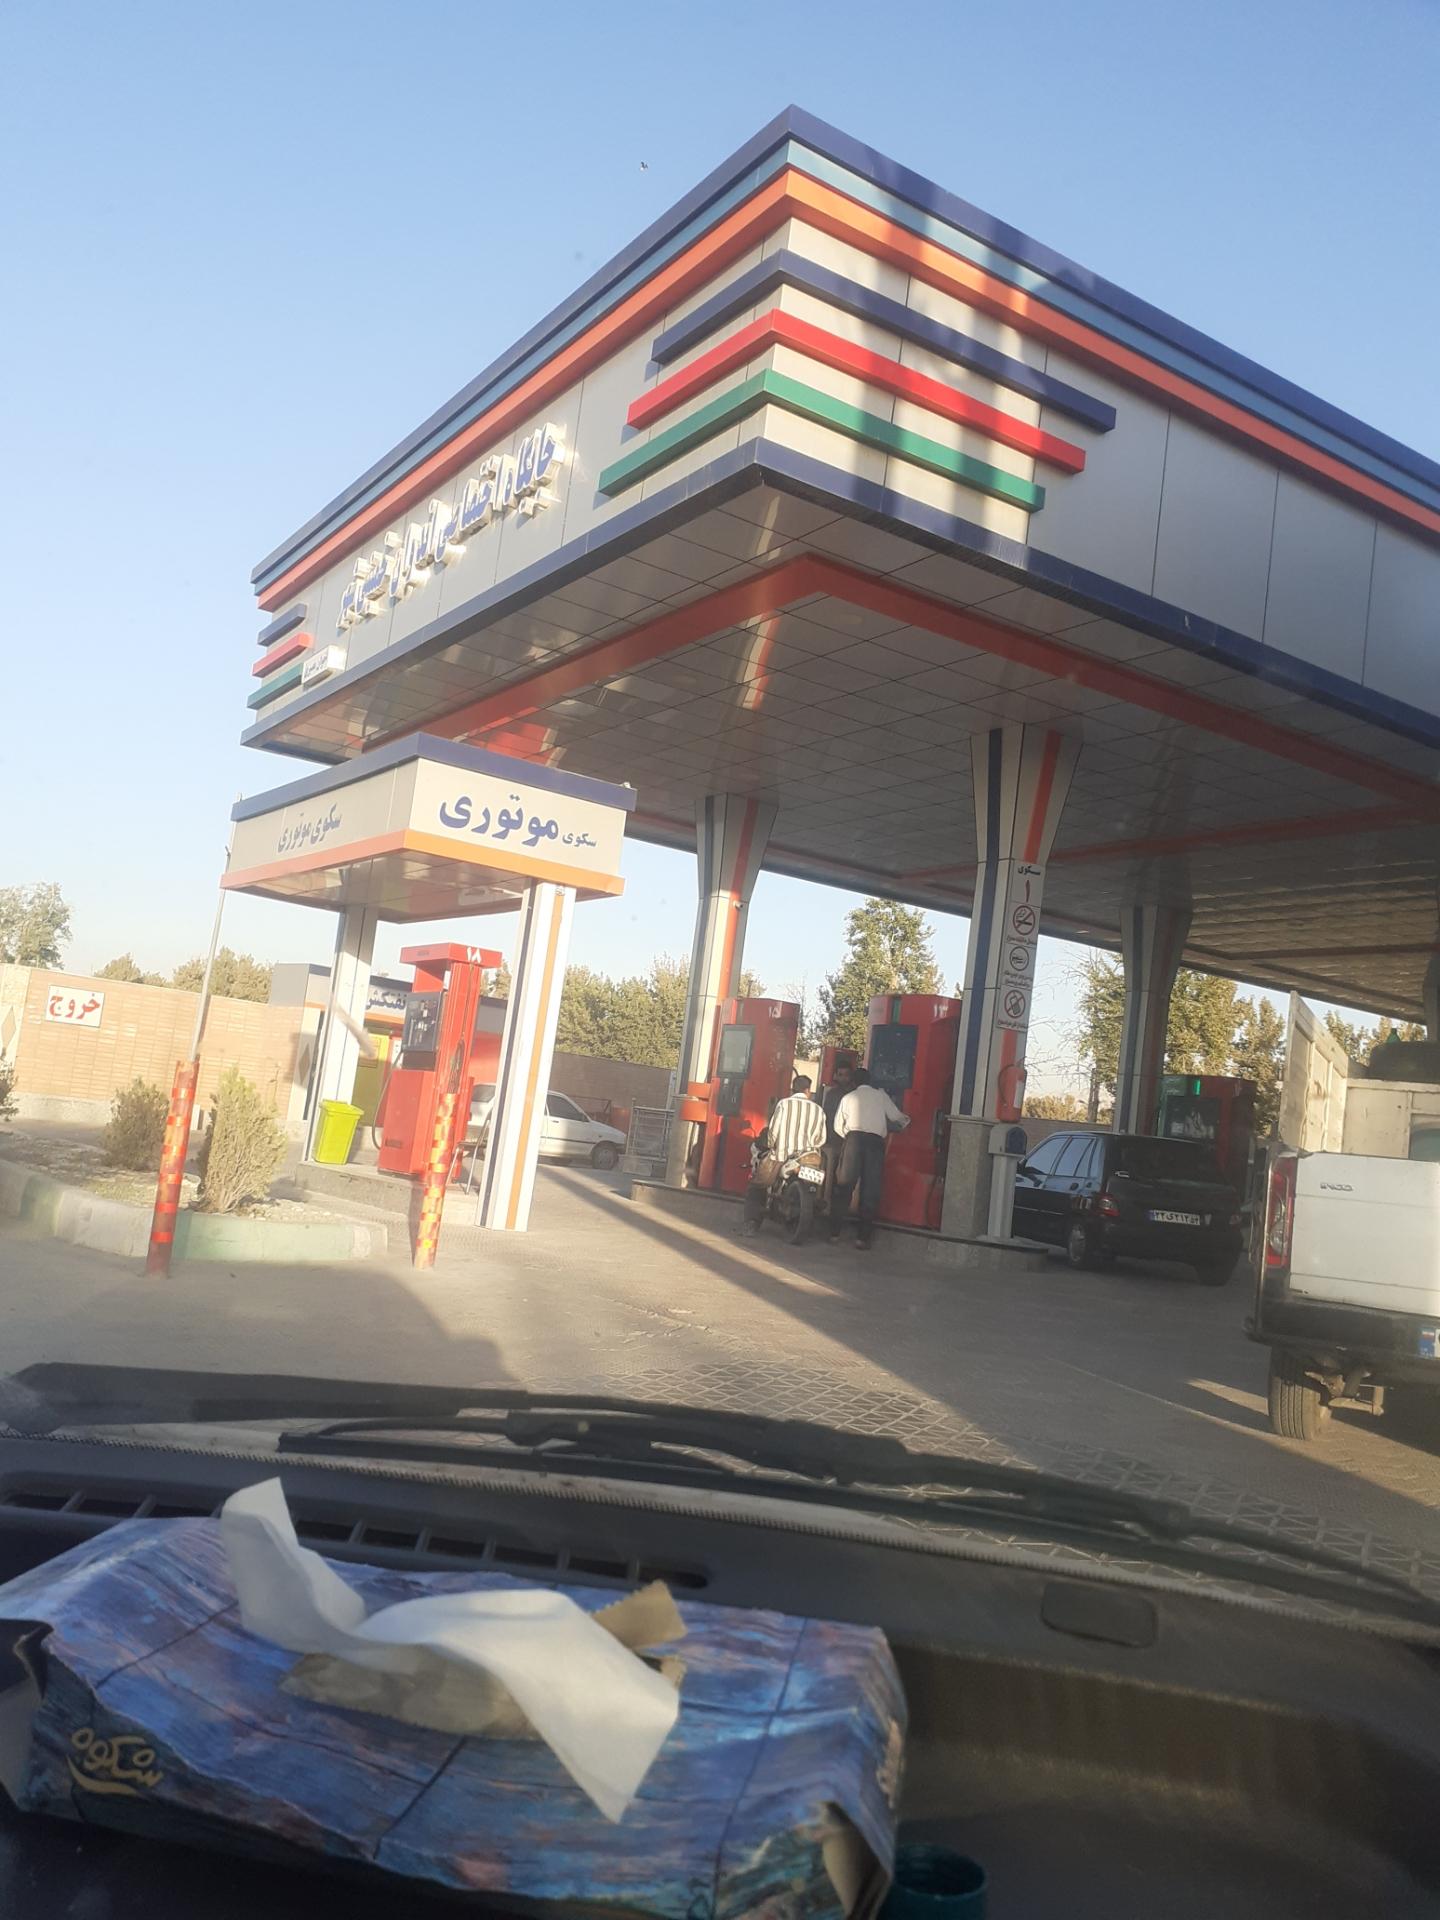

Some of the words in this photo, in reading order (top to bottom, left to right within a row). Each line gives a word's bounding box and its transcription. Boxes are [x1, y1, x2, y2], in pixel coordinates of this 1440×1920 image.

[277, 812, 311, 853] موتوری
[310, 802, 342, 845] سکوی
[439, 794, 559, 847] موتوری
[562, 832, 598, 848] سکوی
[1018, 866, 1041, 876] سکوی
[466, 946, 482, 964] ۱۸
[49, 992, 101, 1020] خروج
[365, 990, 407, 1010] نفتکش
